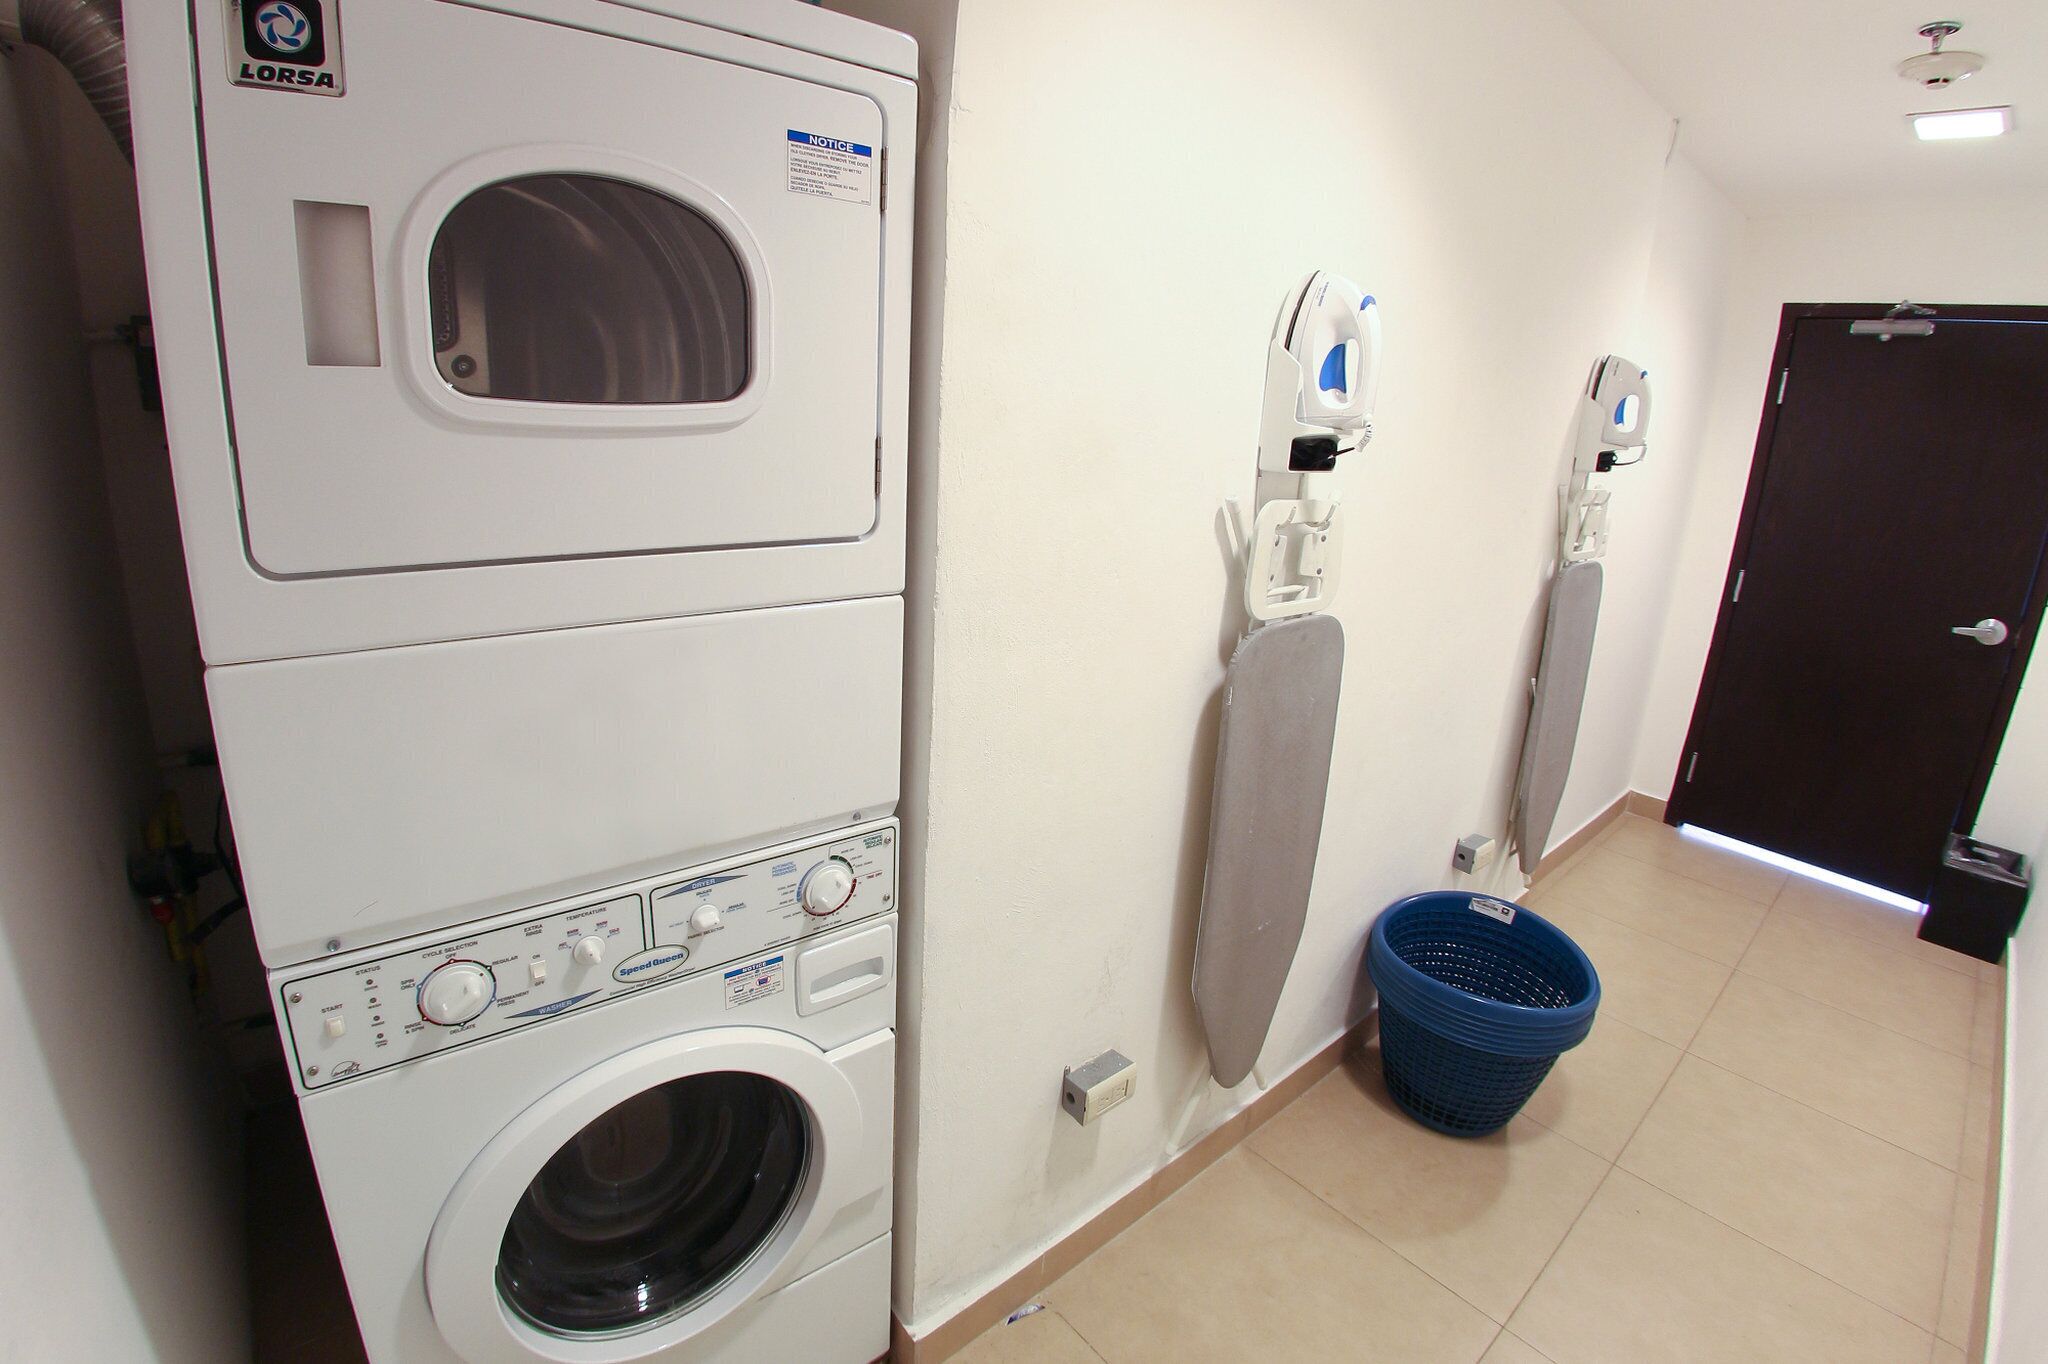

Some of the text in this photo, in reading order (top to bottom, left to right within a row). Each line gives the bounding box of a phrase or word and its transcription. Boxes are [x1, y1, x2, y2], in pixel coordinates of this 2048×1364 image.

[240, 63, 335, 88] LORSA
[809, 134, 854, 152] NOTICE
[692, 879, 716, 889] DRYER
[567, 907, 606, 920] TEMPERATURE
[524, 924, 543, 932] EXTRA
[422, 941, 478, 959] CYCLE SELECTION
[492, 955, 518, 965] REGULAR
[620, 953, 683, 976] Speed Queen
[355, 965, 381, 976] STATUS
[742, 962, 766, 972] NOTICE
[497, 990, 529, 1003] PERMANENT
[321, 1004, 343, 1013] START
[497, 1000, 515, 1008] PRESS
[539, 999, 572, 1014] WASHER
[404, 1021, 422, 1030] RINSE
[449, 1023, 476, 1035] DELICATE
